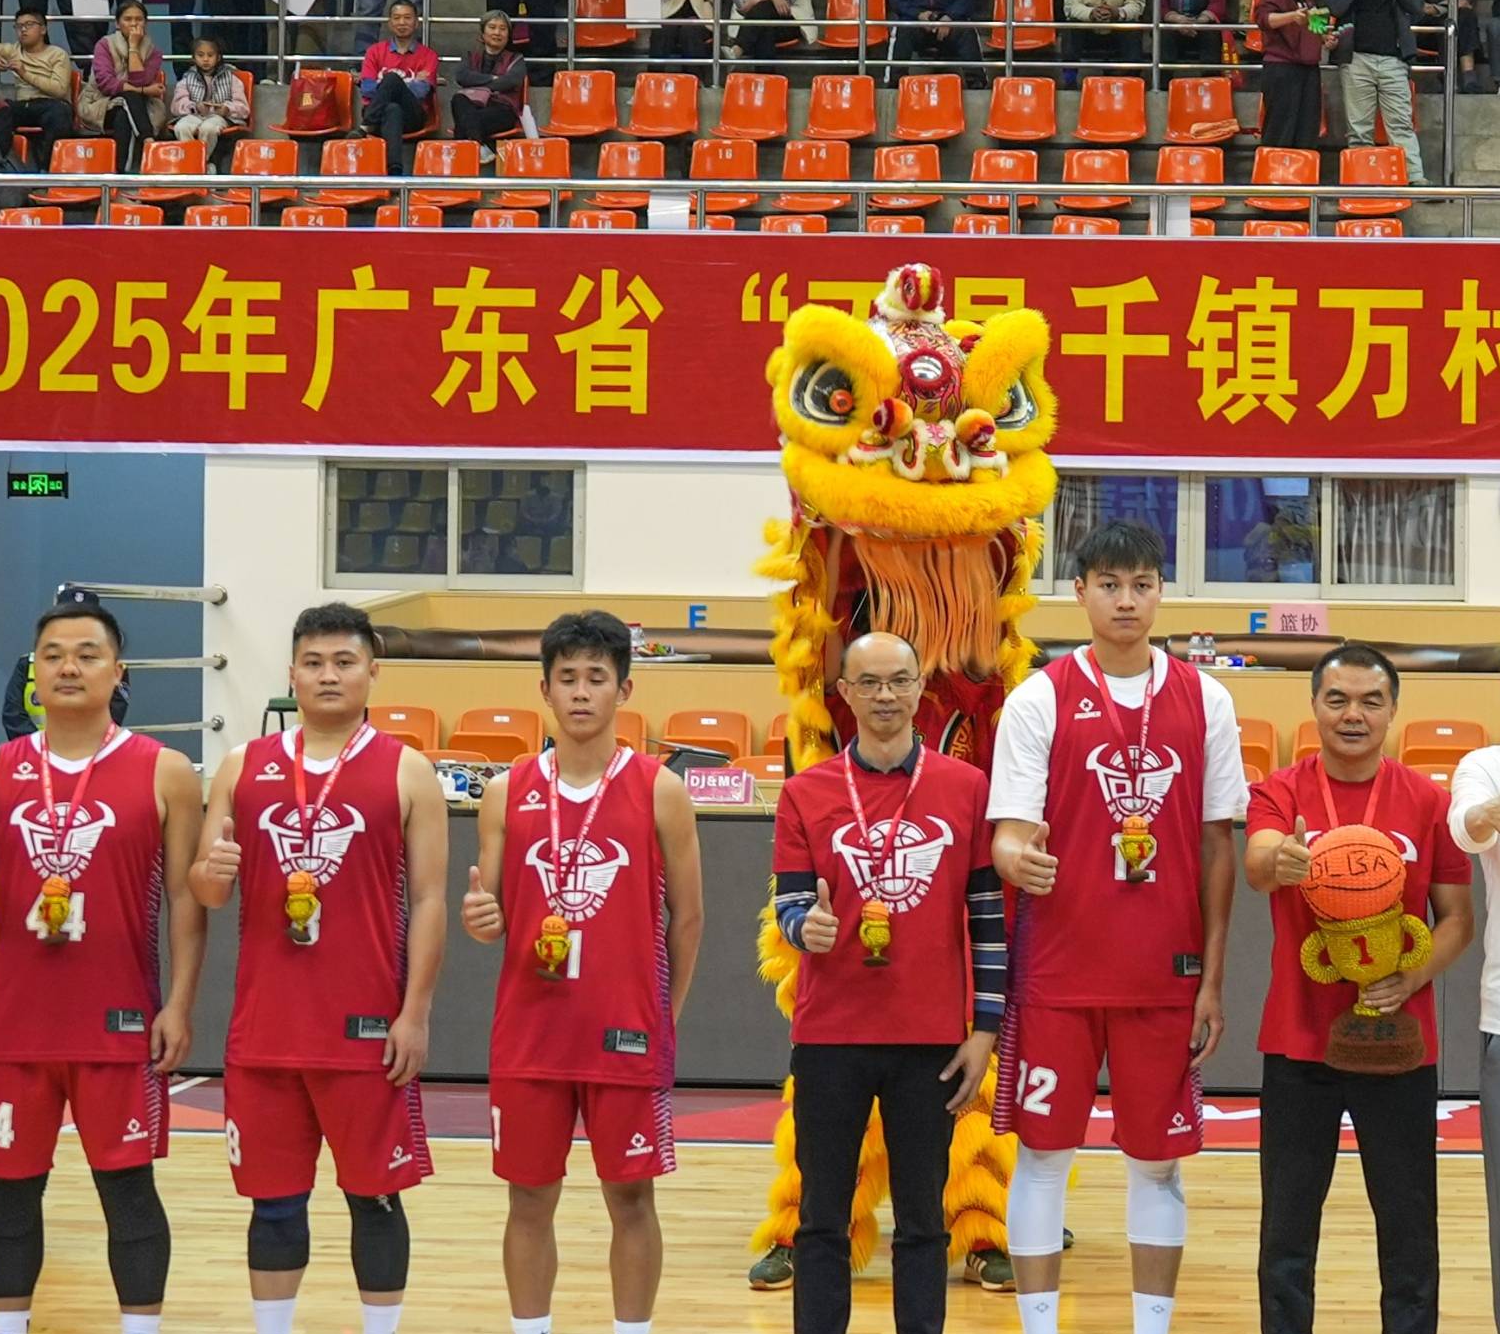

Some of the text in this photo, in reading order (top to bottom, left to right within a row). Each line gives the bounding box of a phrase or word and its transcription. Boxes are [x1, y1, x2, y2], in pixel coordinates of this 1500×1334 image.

[1280, 609, 1319, 628] 篮协
[690, 775, 741, 789] DJ&MC
[1351, 936, 1374, 966] 1
[1015, 1059, 1059, 1117] 12
